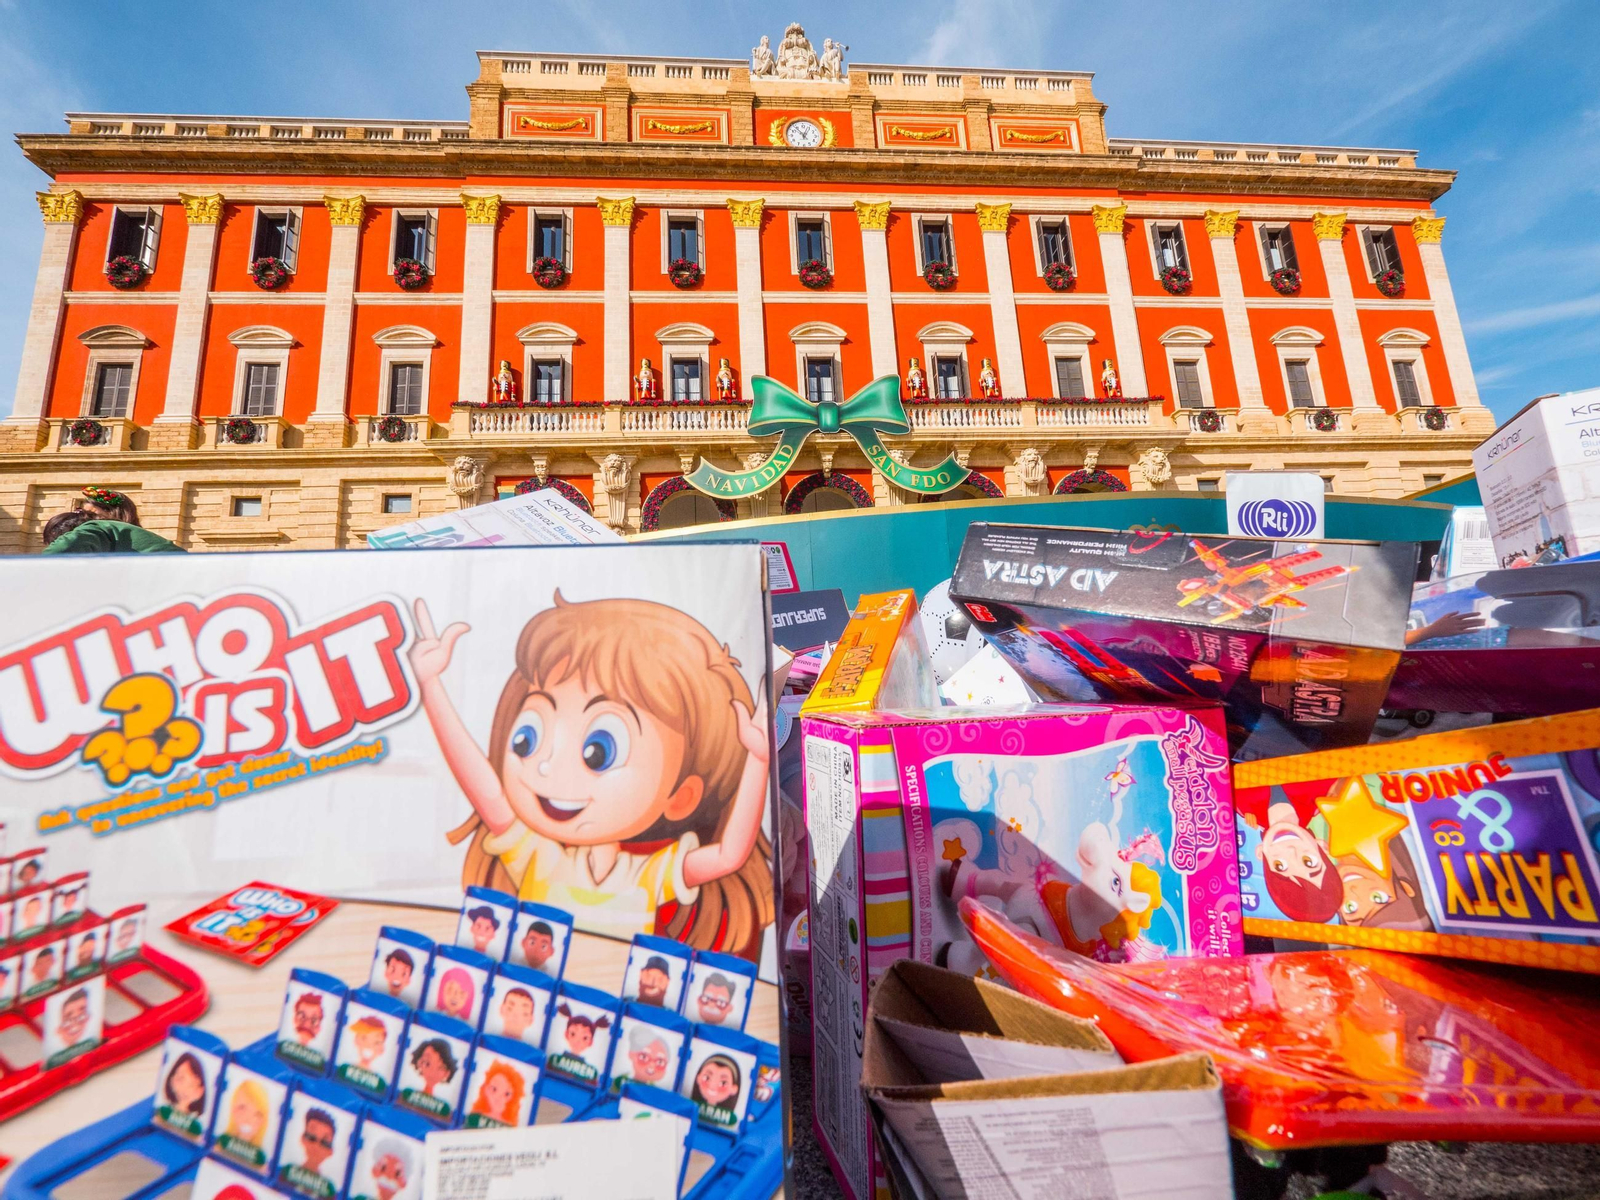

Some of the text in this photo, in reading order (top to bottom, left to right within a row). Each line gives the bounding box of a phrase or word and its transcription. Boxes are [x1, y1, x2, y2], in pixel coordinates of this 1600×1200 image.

[706, 444, 794, 493] NAVIDAD
[867, 444, 951, 488] SAN FDO
[523, 504, 555, 526] Altavoz
[1046, 538, 1104, 549] PERFORMANCE
[1069, 547, 1104, 557] QUALITY
[982, 558, 1119, 593] AD ASTRA
[0, 600, 399, 762] WHO IS IT
[1293, 647, 1348, 723] AD ASTRA
[167, 775, 201, 796] and
[204, 766, 238, 788] get
[218, 780, 248, 798] the
[1378, 751, 1513, 804] JUNIOR
[904, 765, 926, 854] SPECIFICATIONS
[1165, 741, 1197, 866] small pegasus
[1185, 757, 1217, 845] eidolon
[1434, 788, 1515, 854] & CO
[916, 856, 931, 909] COLOURS
[1441, 851, 1600, 923] PARTY
[234, 888, 302, 914] WHO
[1207, 909, 1218, 920] it
[196, 913, 244, 934] IT
[919, 910, 932, 936] AND
[1209, 924, 1220, 950] will
[344, 1066, 382, 1090] KEVIN
[552, 1055, 597, 1081] LAUREN
[407, 1090, 446, 1115] JENNY
